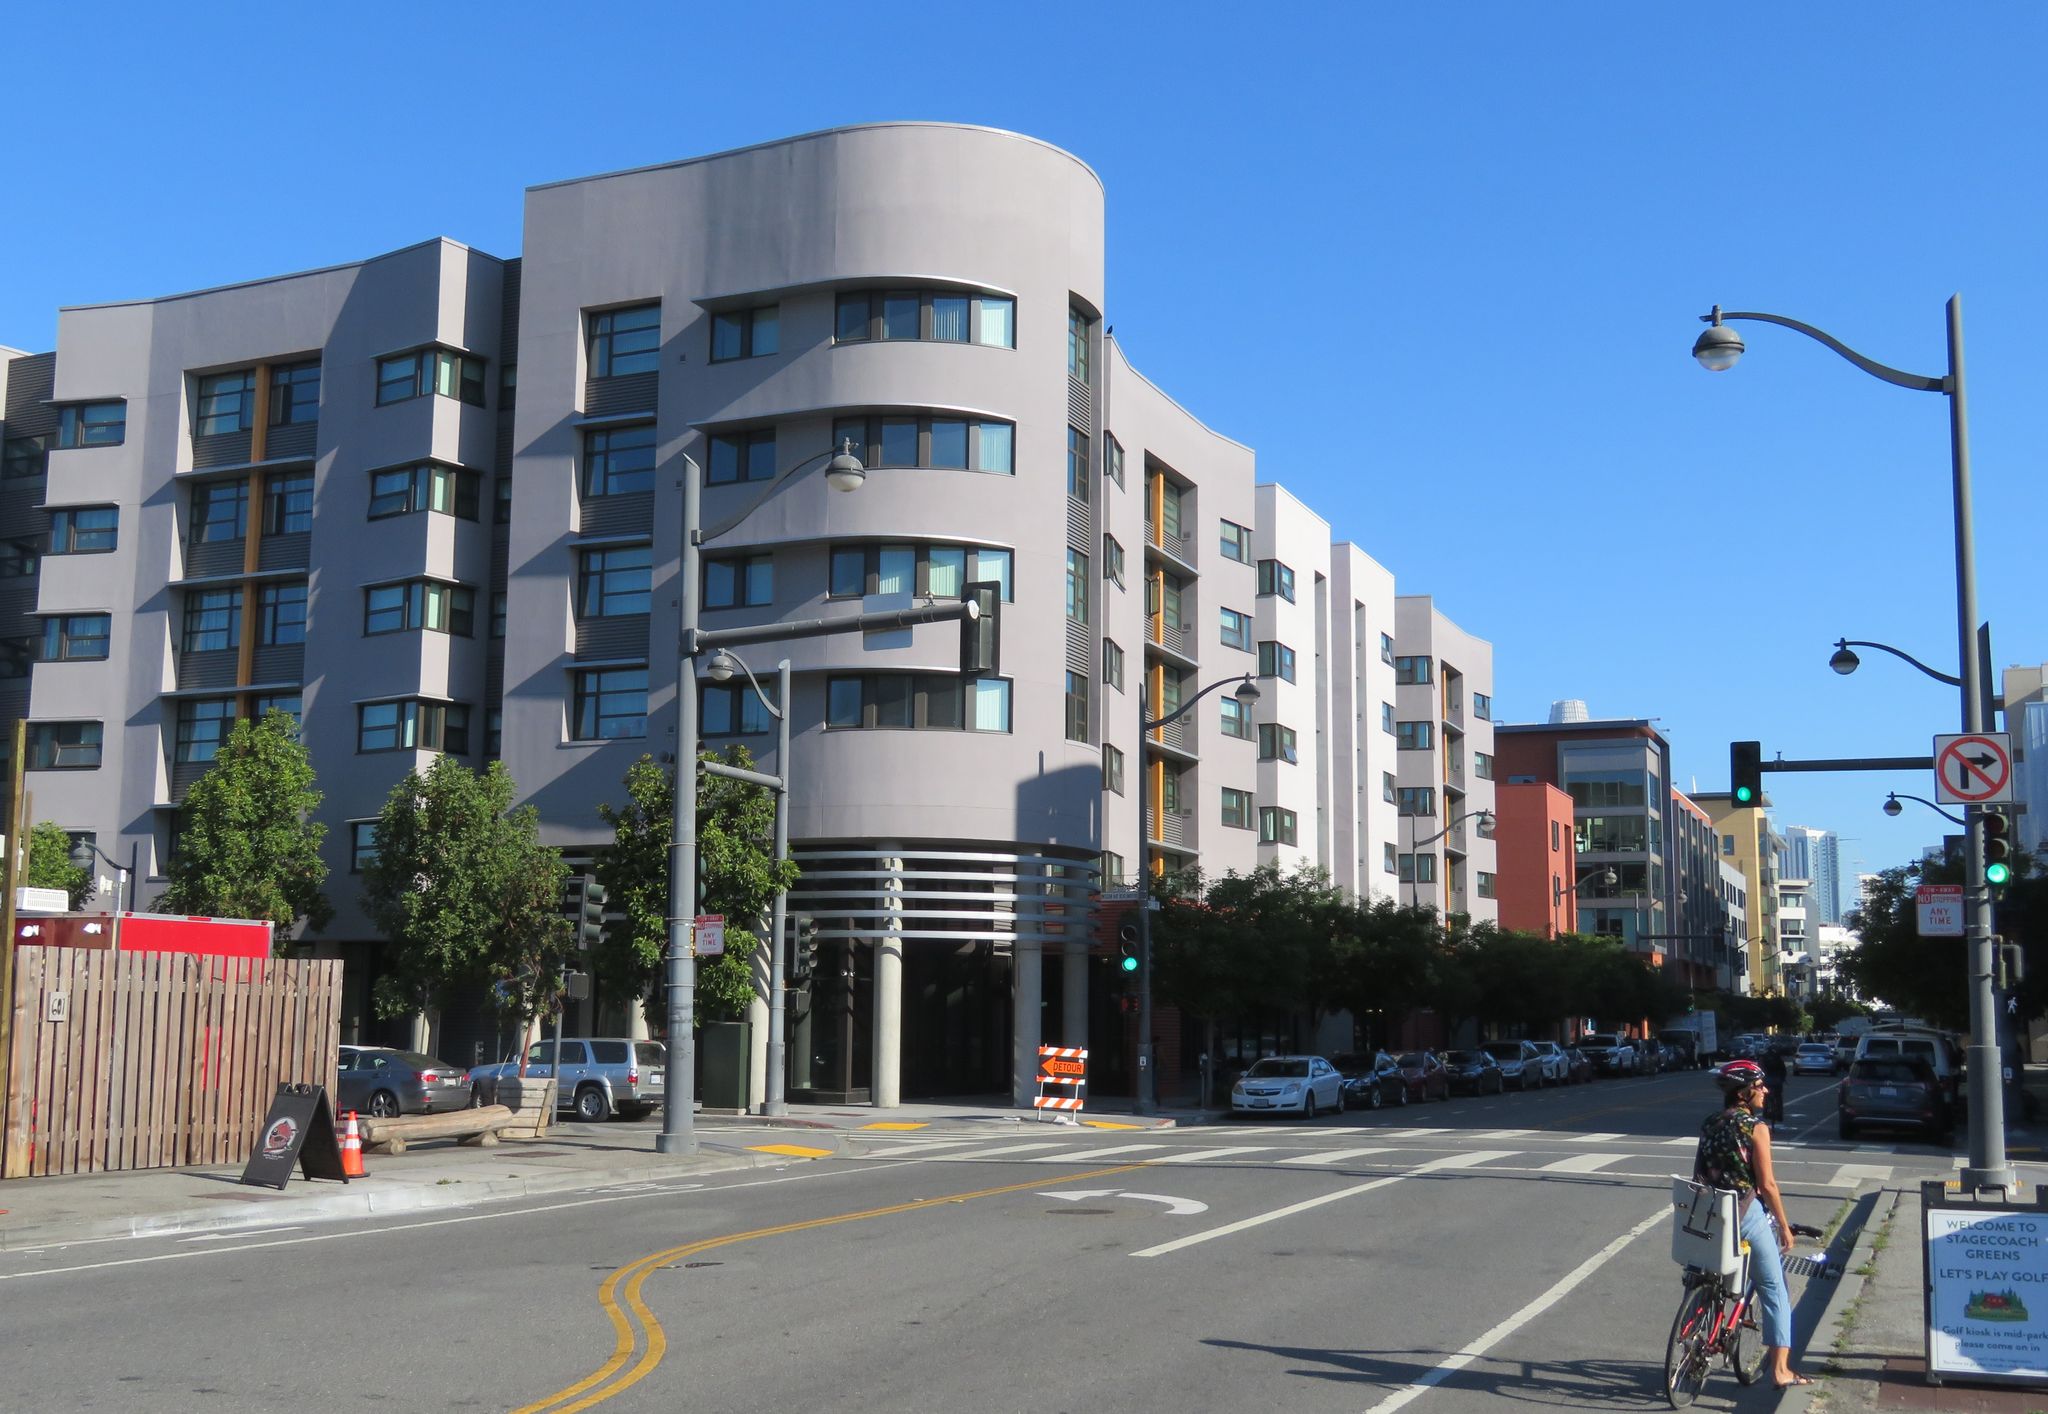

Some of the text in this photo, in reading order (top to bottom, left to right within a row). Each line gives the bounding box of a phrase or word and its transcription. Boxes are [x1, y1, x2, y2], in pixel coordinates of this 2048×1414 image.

[1918, 894, 1931, 904] NO
[1930, 907, 1949, 915] ANY
[1929, 917, 1952, 925] TIME
[1053, 1063, 1082, 1073] DETOUR
[1946, 1220, 2037, 1232] WELCOME TO
[1946, 1234, 2039, 1247] STAGECOACH
[1965, 1249, 2021, 1261] GREENS
[1940, 1269, 2048, 1283] LET'S PLAY GOLF
[1942, 1326, 1963, 1335] Golf
[1966, 1327, 1991, 1336] kiosk
[1993, 1328, 2001, 1337] is
[1955, 1339, 1984, 1350] please
[1986, 1342, 2013, 1351] come
[2030, 1343, 2040, 1352] in
